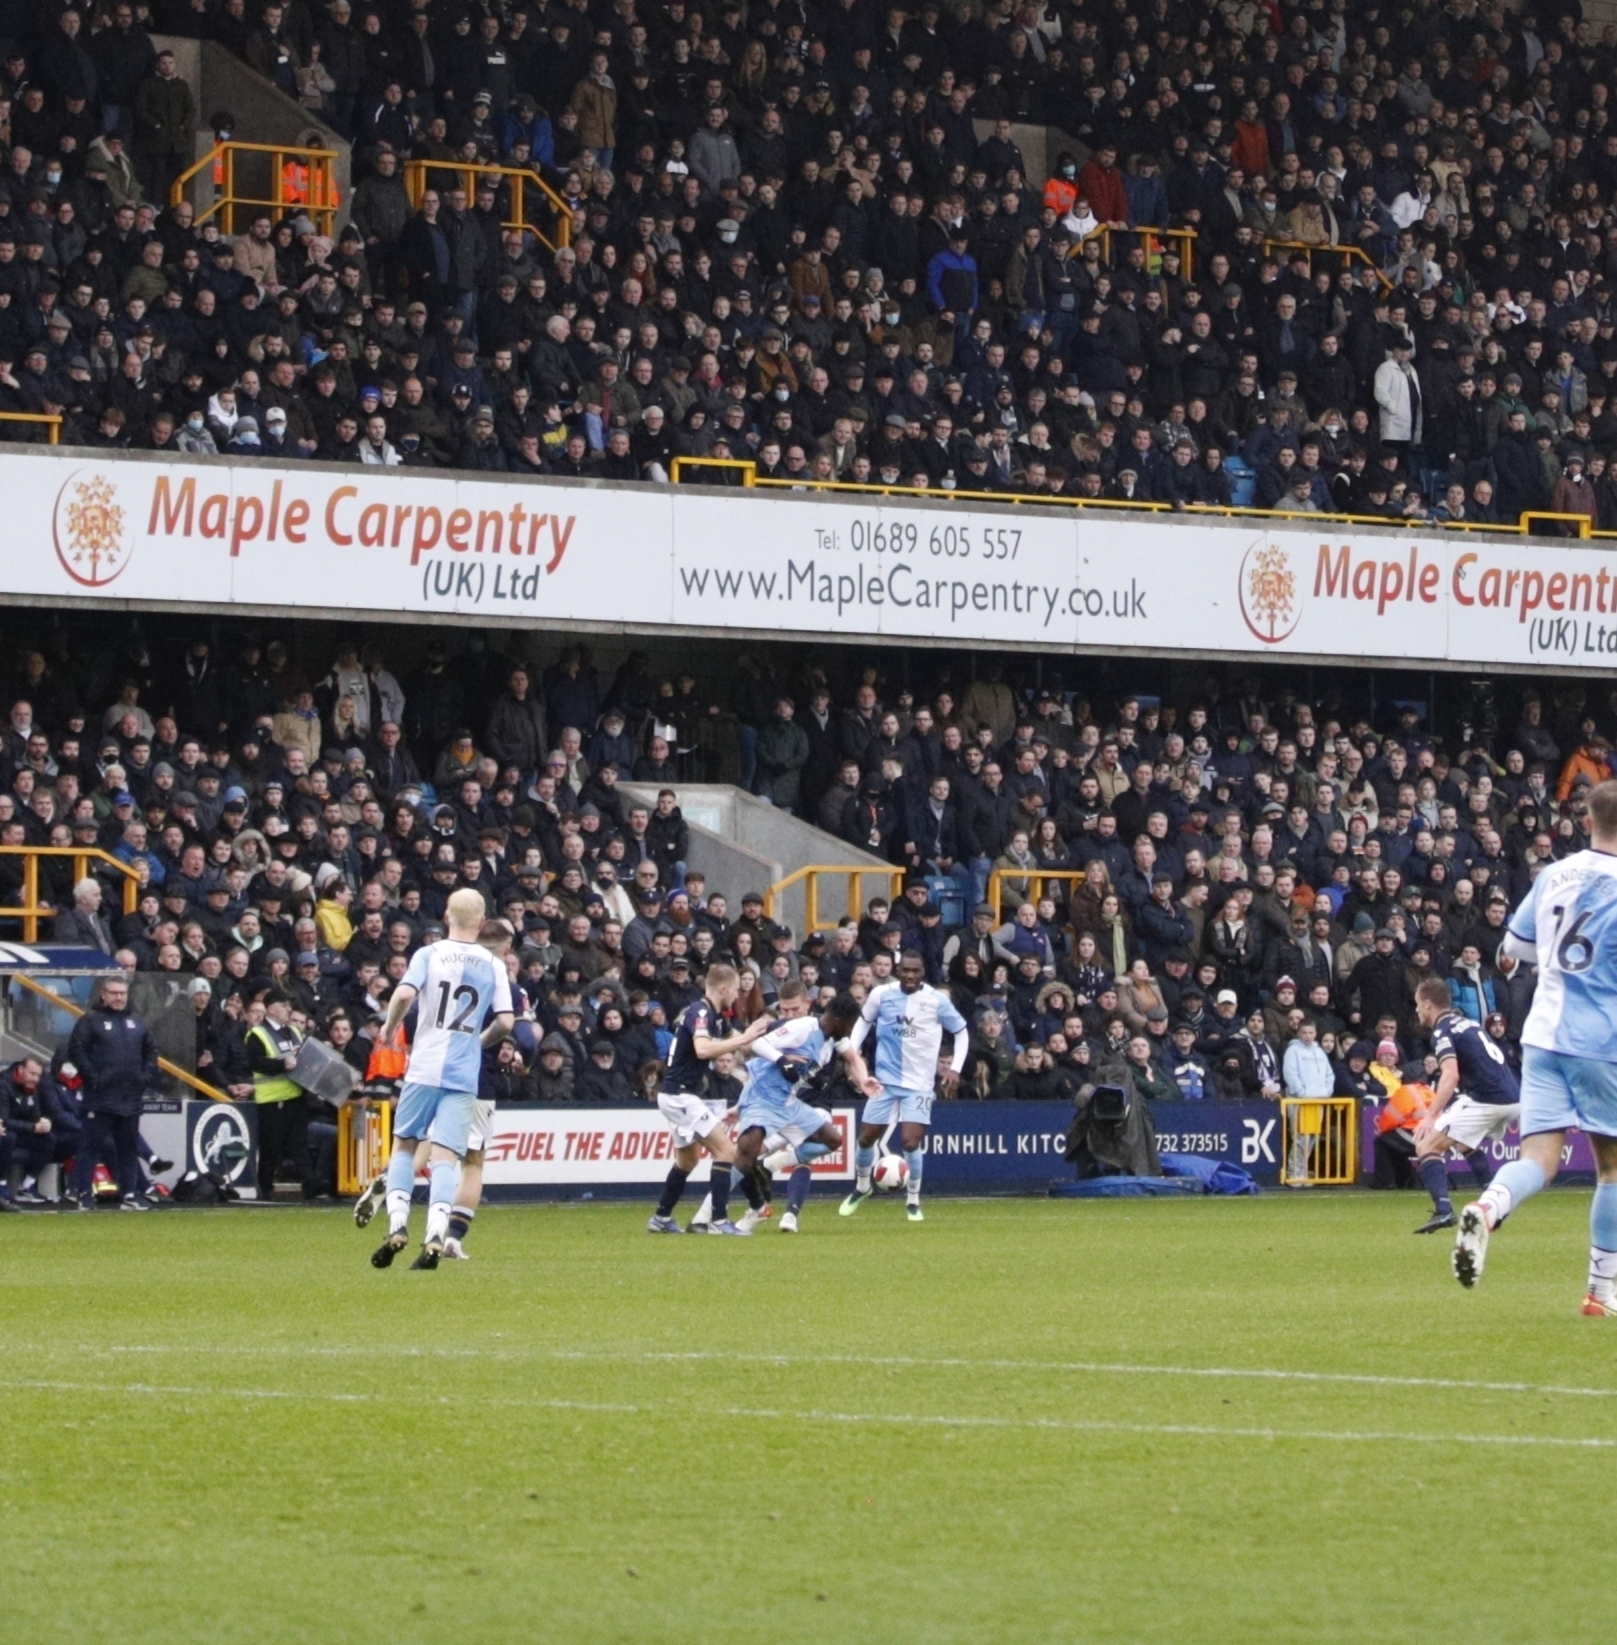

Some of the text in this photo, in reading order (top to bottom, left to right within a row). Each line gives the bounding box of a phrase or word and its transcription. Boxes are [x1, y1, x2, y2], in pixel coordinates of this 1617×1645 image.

[147, 475, 576, 575] Maple Carpentry
[814, 519, 1022, 561] Tel: 01689 605 557
[422, 558, 541, 603] (UK) Ltd
[680, 558, 1148, 627] www.MapleCarpentry.co.uk
[1313, 543, 1440, 616] Maple
[1528, 616, 1578, 657] (UK)
[1545, 905, 1594, 972] 16
[440, 953, 488, 973] HUGHES
[435, 979, 479, 1034] 12
[891, 1027, 917, 1038] W88
[484, 1131, 555, 1162] FUEL
[564, 1131, 606, 1162] THE
[1017, 1133, 1067, 1154] KITC
[1155, 1133, 1228, 1153] 732 373515
